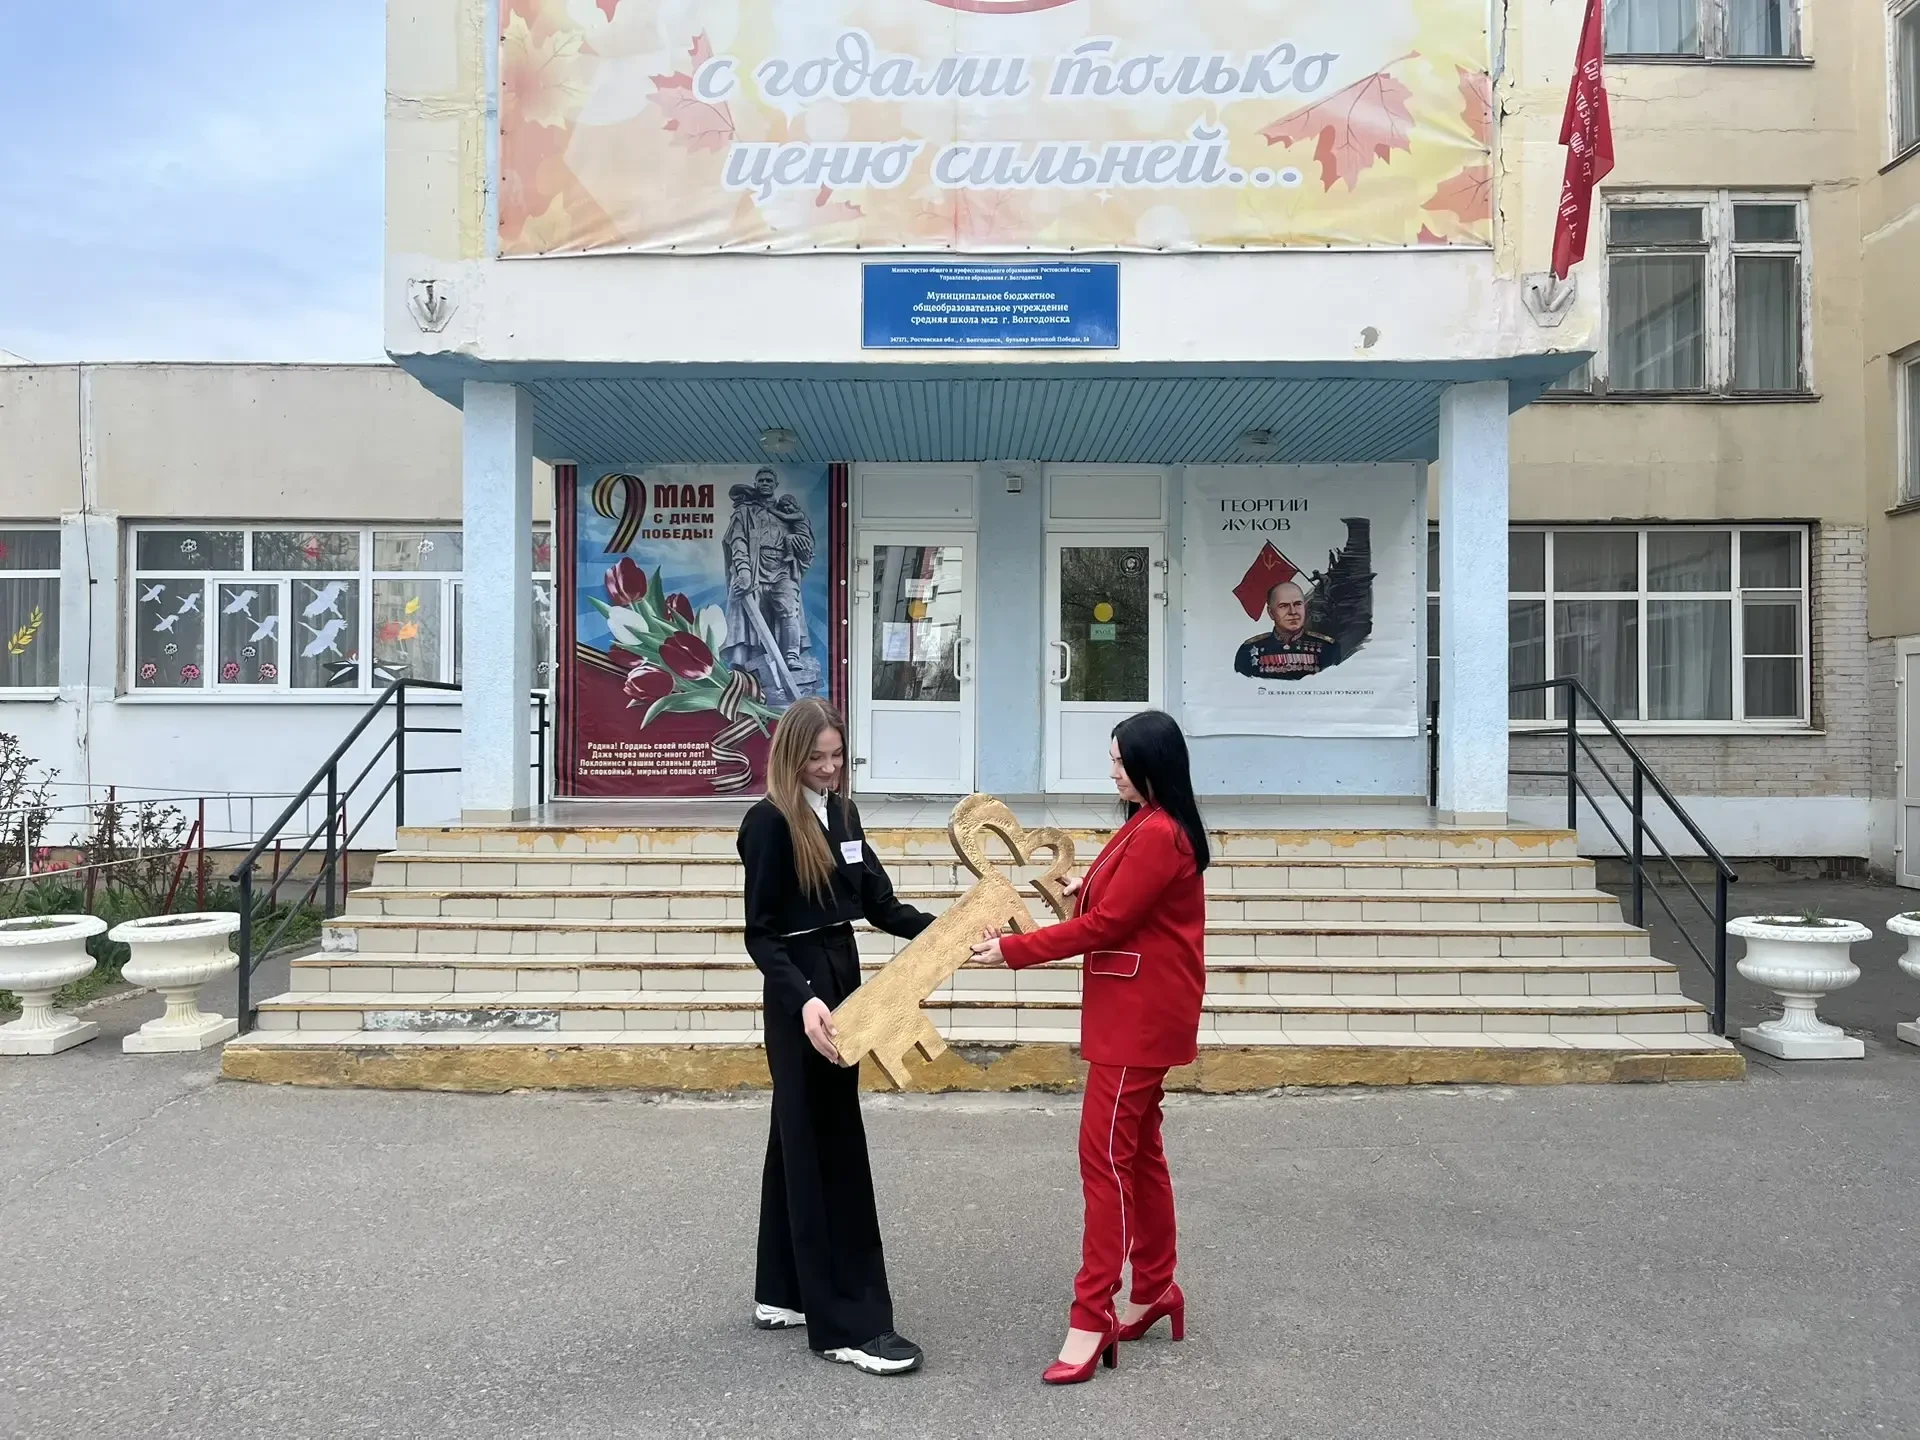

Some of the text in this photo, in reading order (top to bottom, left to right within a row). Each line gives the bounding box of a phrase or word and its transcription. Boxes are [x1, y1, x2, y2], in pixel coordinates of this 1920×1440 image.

[697, 33, 1341, 98] с годами только
[725, 124, 1298, 200] ценю сильней...
[926, 291, 1056, 301] Муниципальное бюджетное
[912, 303, 1069, 313] общеобразовательное учреждение
[911, 316, 948, 324] средняя
[950, 316, 979, 324] школа
[1012, 315, 1071, 324] Волгодонска
[1220, 497, 1308, 513] ГЕОРГИЙ
[591, 472, 714, 553] 9 МАЯ
[653, 513, 714, 525] С ДНЕМ
[1221, 518, 1291, 531] ЖУКОВ
[641, 528, 713, 540] ПОБЕДЫ!
[587, 742, 709, 751] Родина! Гордись своей победой
[592, 750, 613, 759] Даже
[614, 751, 636, 759] через
[689, 750, 705, 758] лет!
[580, 759, 626, 767] Поклонимся
[692, 760, 717, 768] дедам
[578, 767, 588, 775] За
[637, 768, 668, 776] мирный
[669, 768, 697, 776] солнца
[698, 767, 718, 775] свет!
